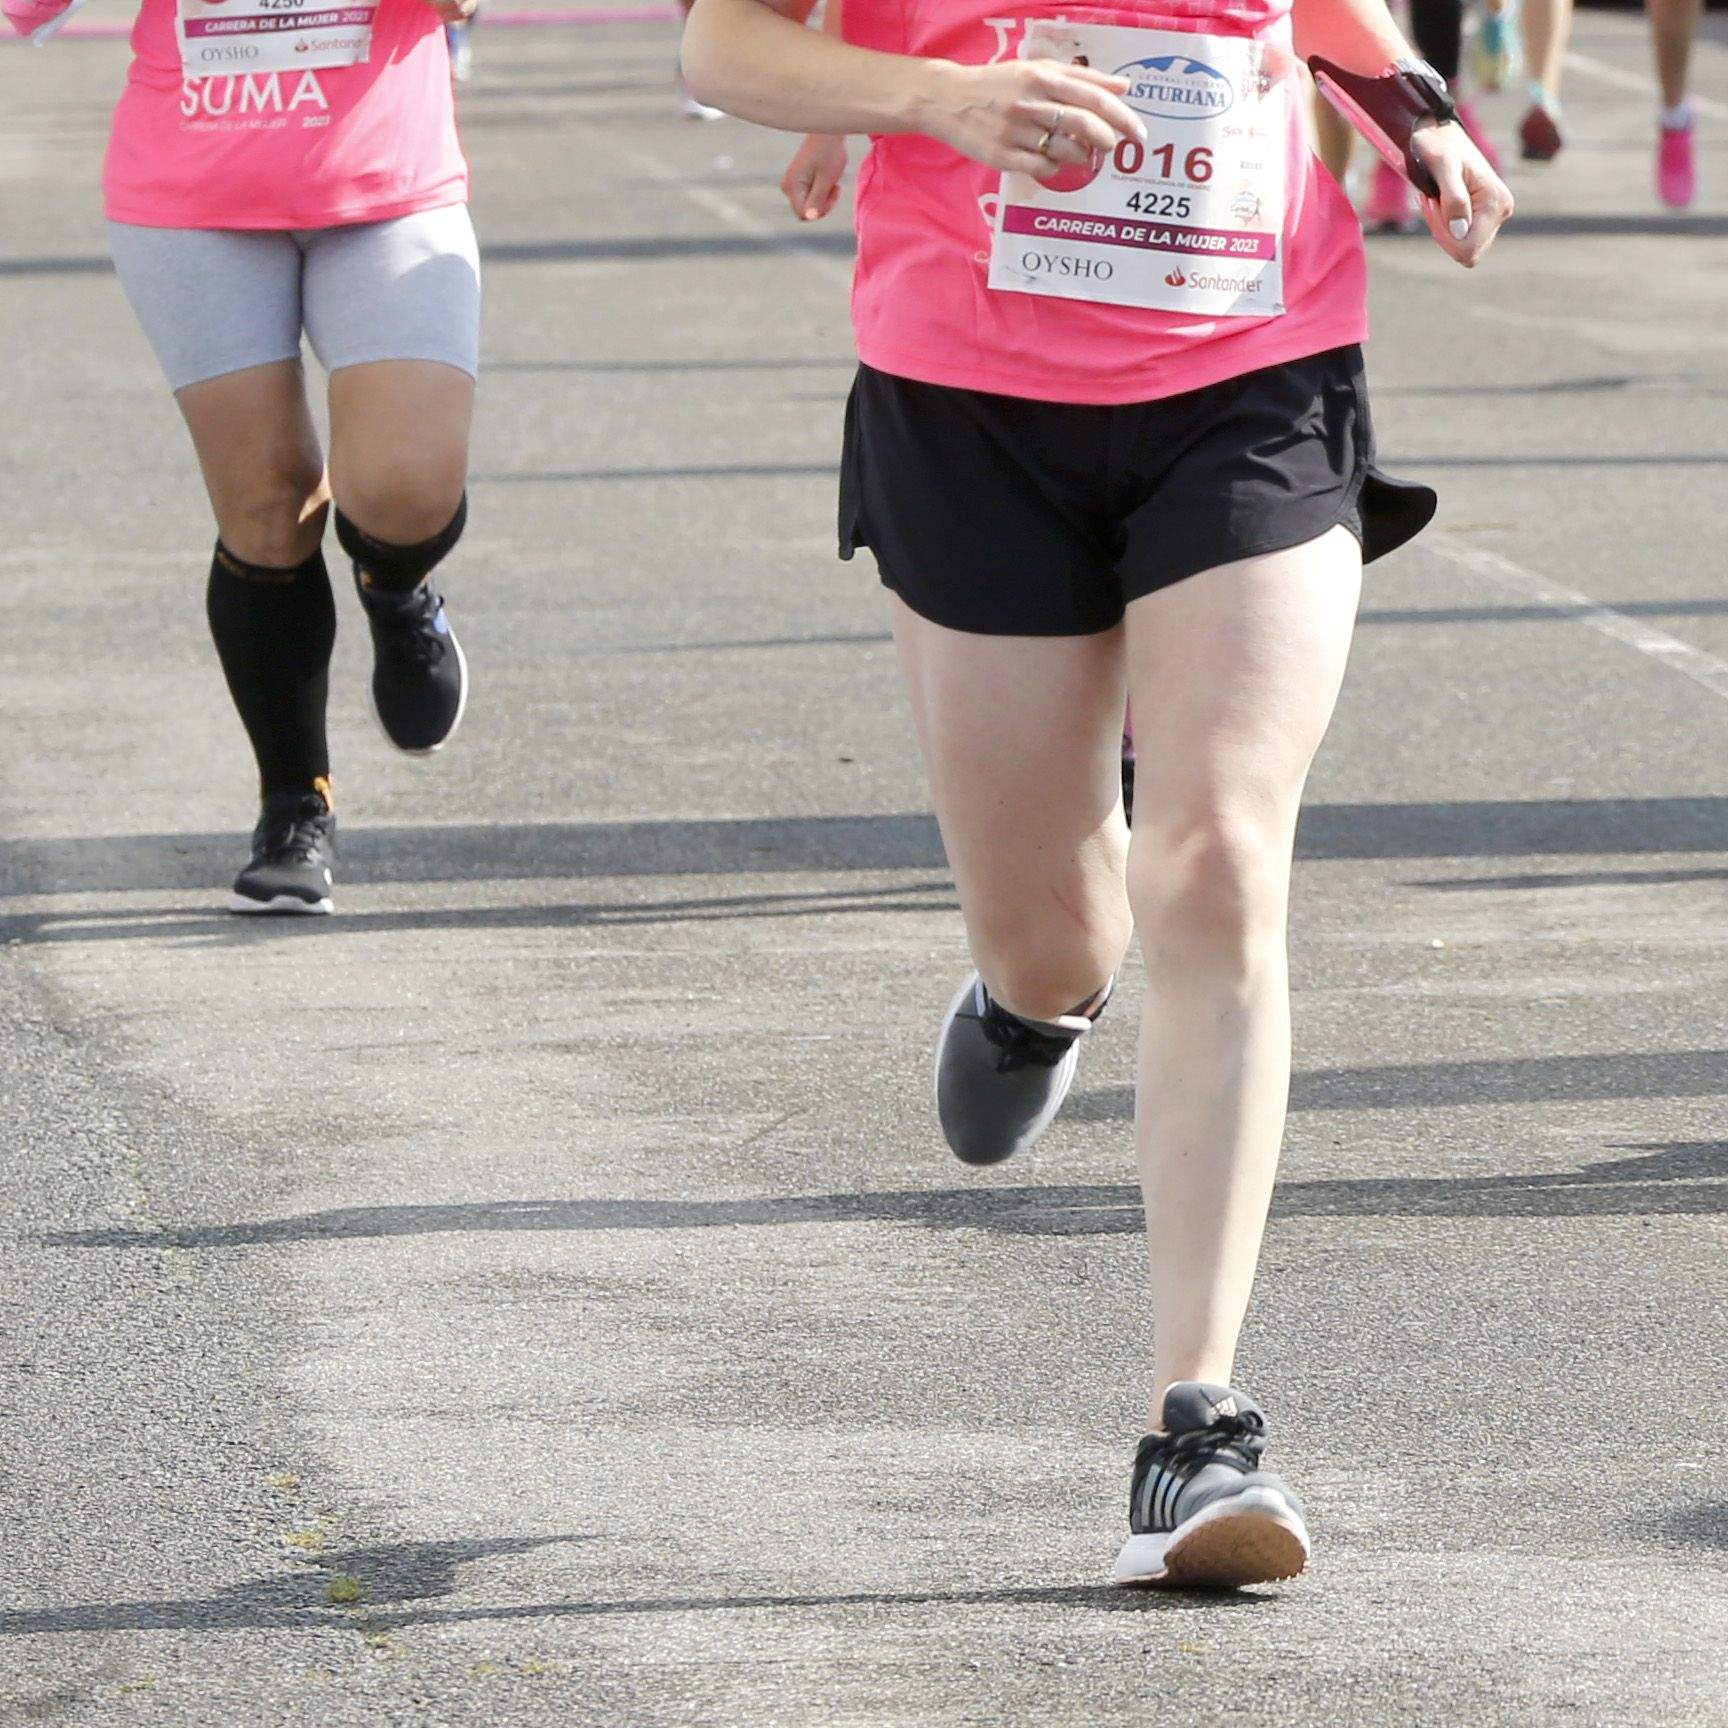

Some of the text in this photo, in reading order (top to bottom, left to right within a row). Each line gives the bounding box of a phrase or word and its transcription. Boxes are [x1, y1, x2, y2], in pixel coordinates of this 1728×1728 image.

[258, 17, 277, 30] DE
[279, 16, 296, 29] LA
[298, 12, 338, 27] MUJER
[201, 46, 259, 62] OYSHO
[180, 69, 329, 117] SUMA
[1113, 138, 1214, 183] 016
[1126, 191, 1191, 218] 4225
[1033, 215, 1260, 254] CARRERA DE LA MUJER 2023
[1021, 251, 1263, 293] OYSHO Santander
